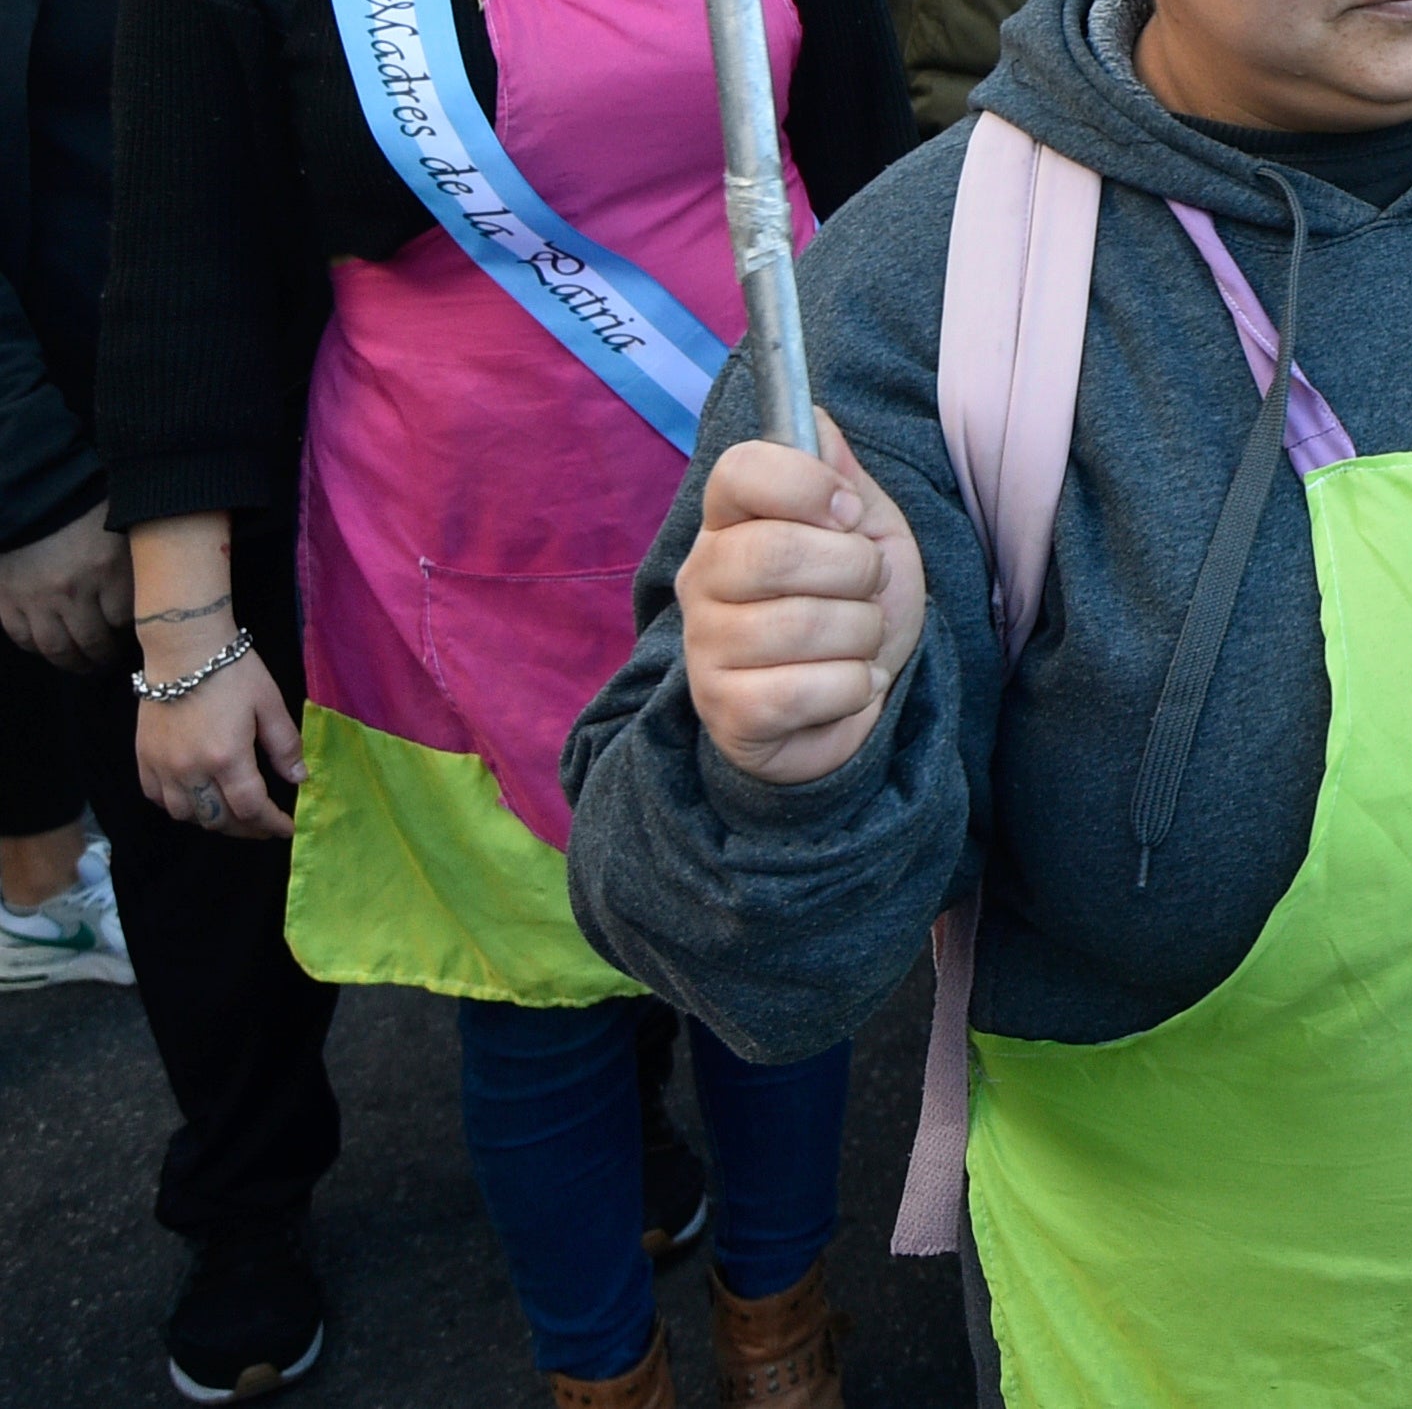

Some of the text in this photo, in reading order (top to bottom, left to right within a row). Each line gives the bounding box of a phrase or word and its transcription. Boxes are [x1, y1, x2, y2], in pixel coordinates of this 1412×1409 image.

[419, 152, 474, 199] de
[462, 208, 514, 241] la
[517, 240, 647, 356] Patria
